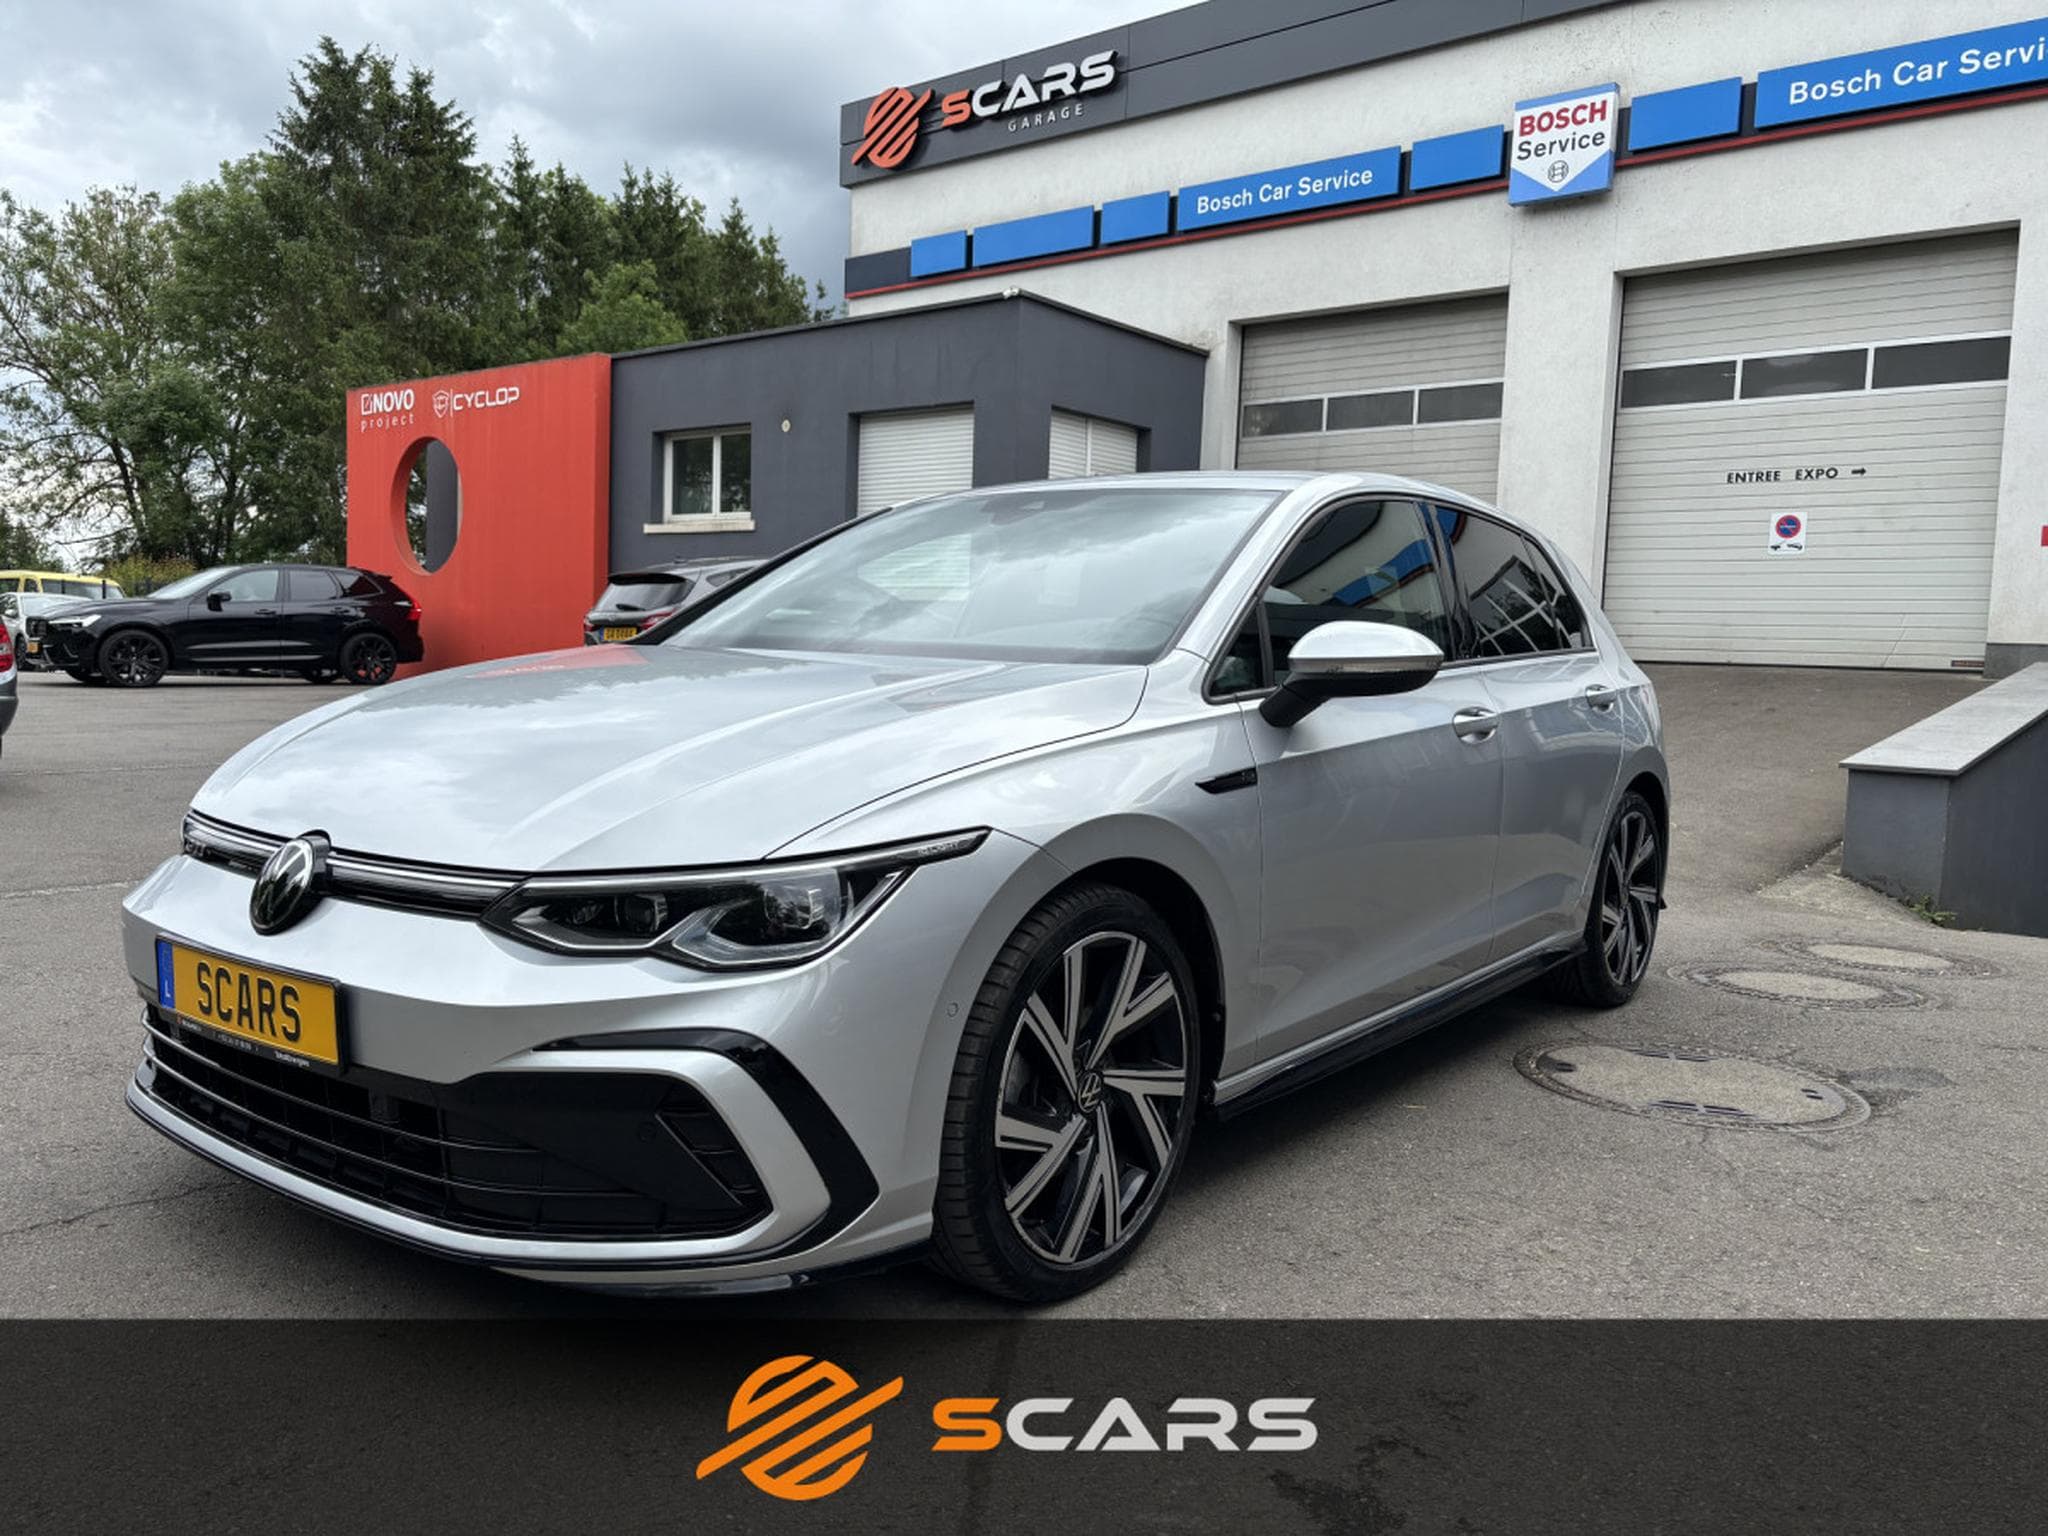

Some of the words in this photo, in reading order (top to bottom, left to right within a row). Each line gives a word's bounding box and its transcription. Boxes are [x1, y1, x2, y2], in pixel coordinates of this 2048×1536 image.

[940, 50, 1116, 128] SCARS
[1789, 68, 1882, 105] Bosch
[1893, 60, 1949, 86] Car
[1007, 103, 1084, 132] GARAGE
[1519, 99, 1607, 137] BOSCH
[1517, 131, 1605, 160] Service
[1197, 188, 1252, 214] Bosch
[1258, 182, 1293, 203] Car
[1297, 169, 1373, 196] Service
[453, 386, 520, 411] CYCLOP
[360, 413, 415, 433] project
[1726, 470, 1781, 484] ENTREE
[1795, 467, 1838, 480] EXPO
[197, 961, 302, 1042] SCARS
